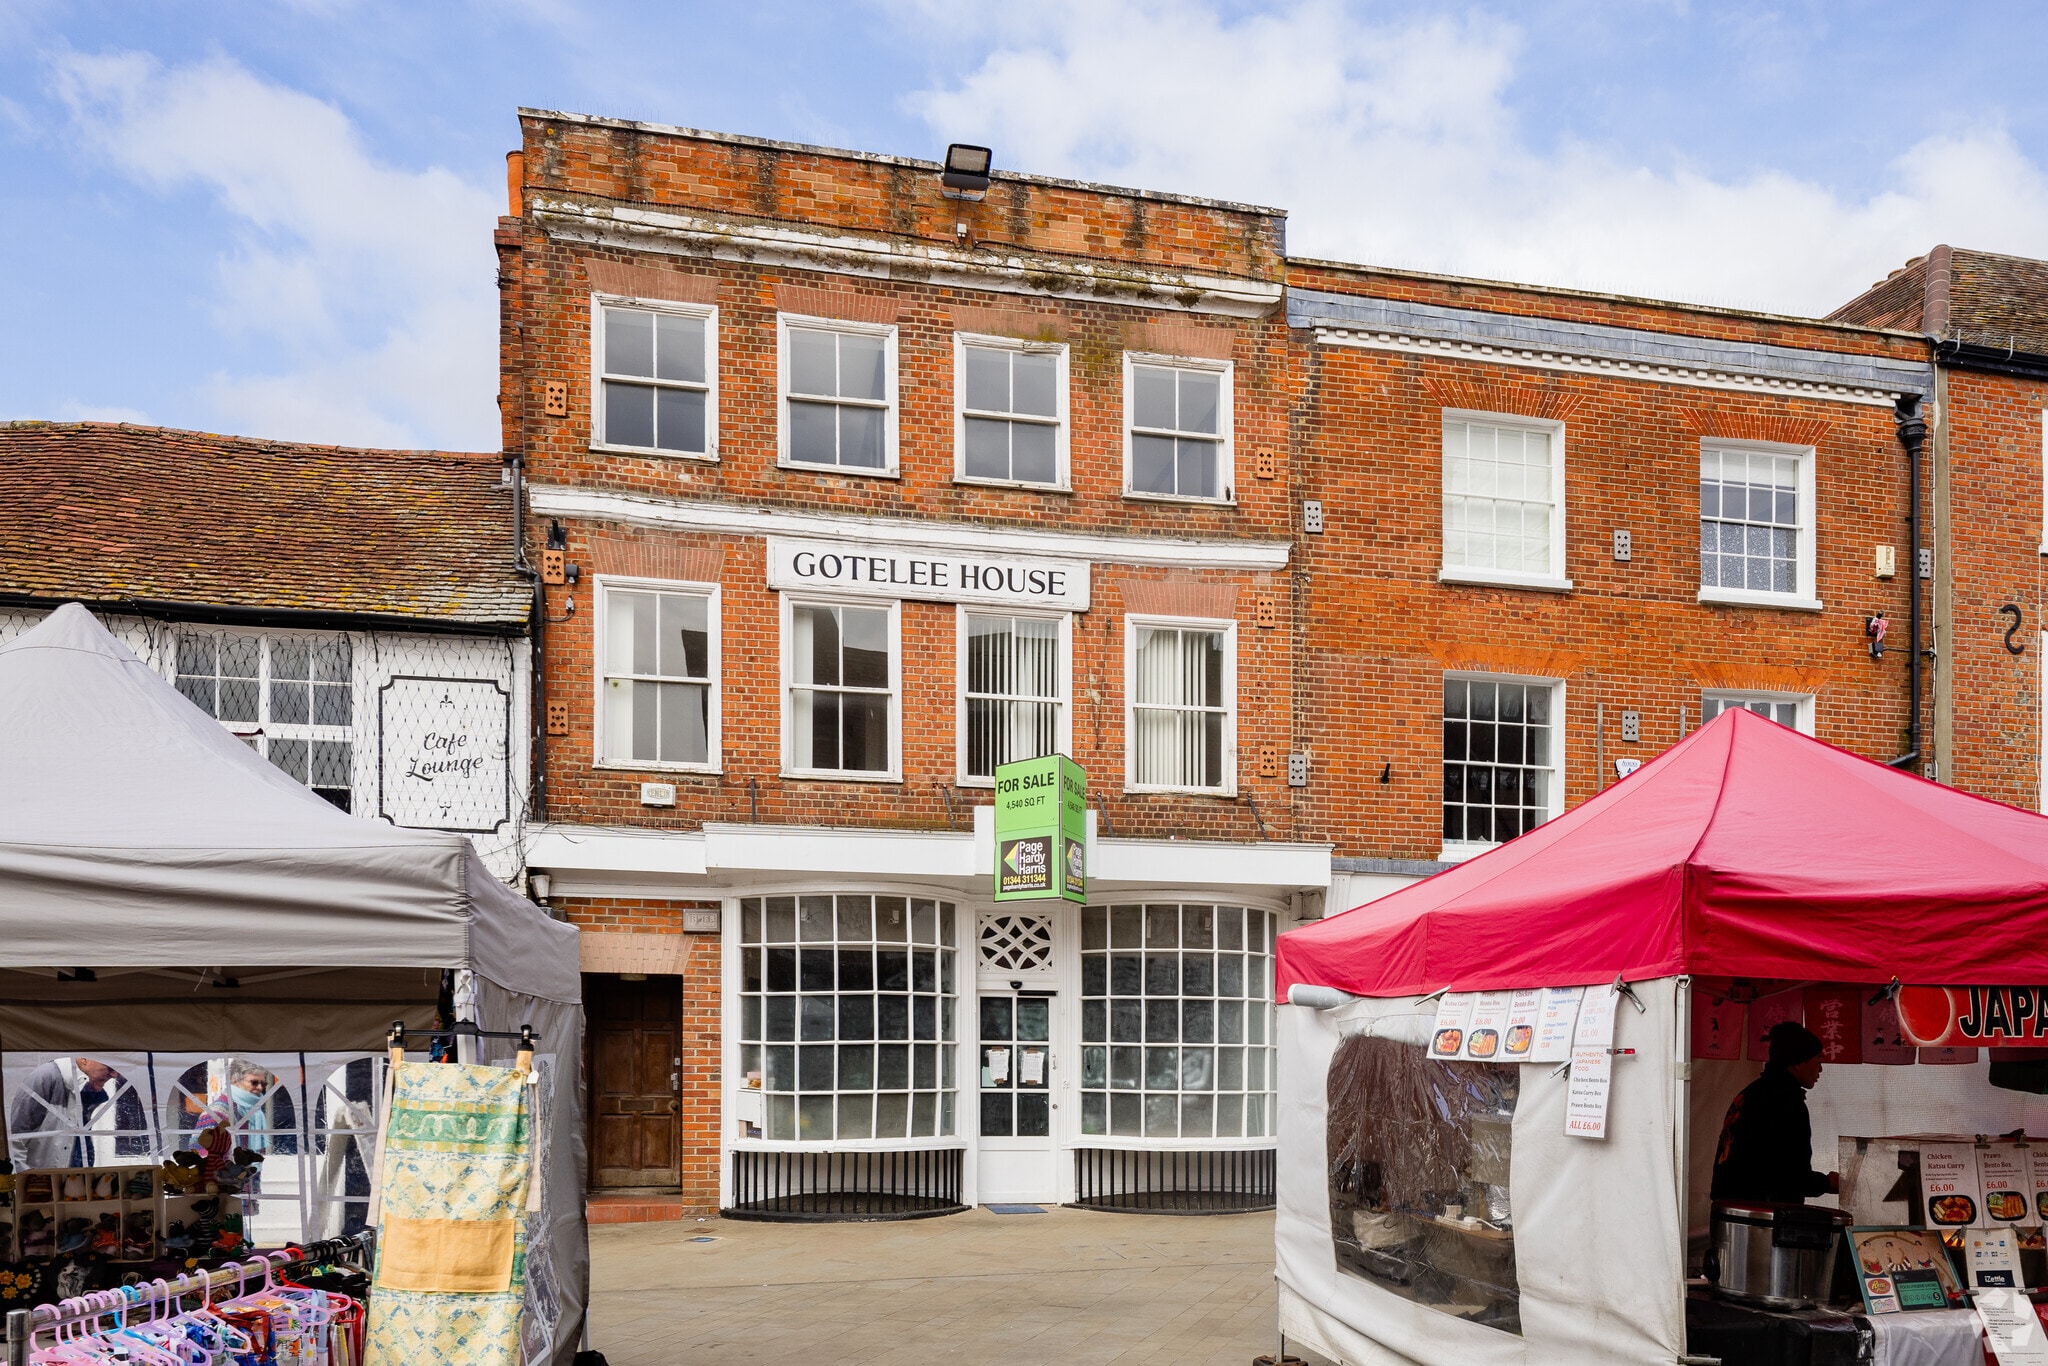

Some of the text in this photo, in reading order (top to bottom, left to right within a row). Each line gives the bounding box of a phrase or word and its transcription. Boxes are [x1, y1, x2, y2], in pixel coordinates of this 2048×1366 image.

[793, 552, 1066, 596] GOTELEE HOUSE
[424, 732, 467, 755] Cafe
[406, 757, 484, 782] Lounge
[998, 772, 1055, 794] FOR SALE
[1064, 775, 1085, 800] FOR SALE
[1006, 795, 1046, 810] 4,540 SQ FT
[1020, 841, 1043, 855] Page
[1020, 851, 1046, 865] Hardy
[1019, 864, 1047, 875] Harris
[1003, 873, 1047, 885] 01344 311344
[1515, 990, 1533, 998] Chicken
[1476, 1018, 1492, 1026] £6.00
[1511, 1016, 1525, 1025] £6.00
[1569, 1120, 1601, 1131] ALL £6.00
[1947, 1162, 1966, 1170] Curry
[1930, 1183, 1955, 1192] £6.00
[1986, 1180, 2008, 1189] £6.00
[1934, 1292, 1940, 1300] 5
